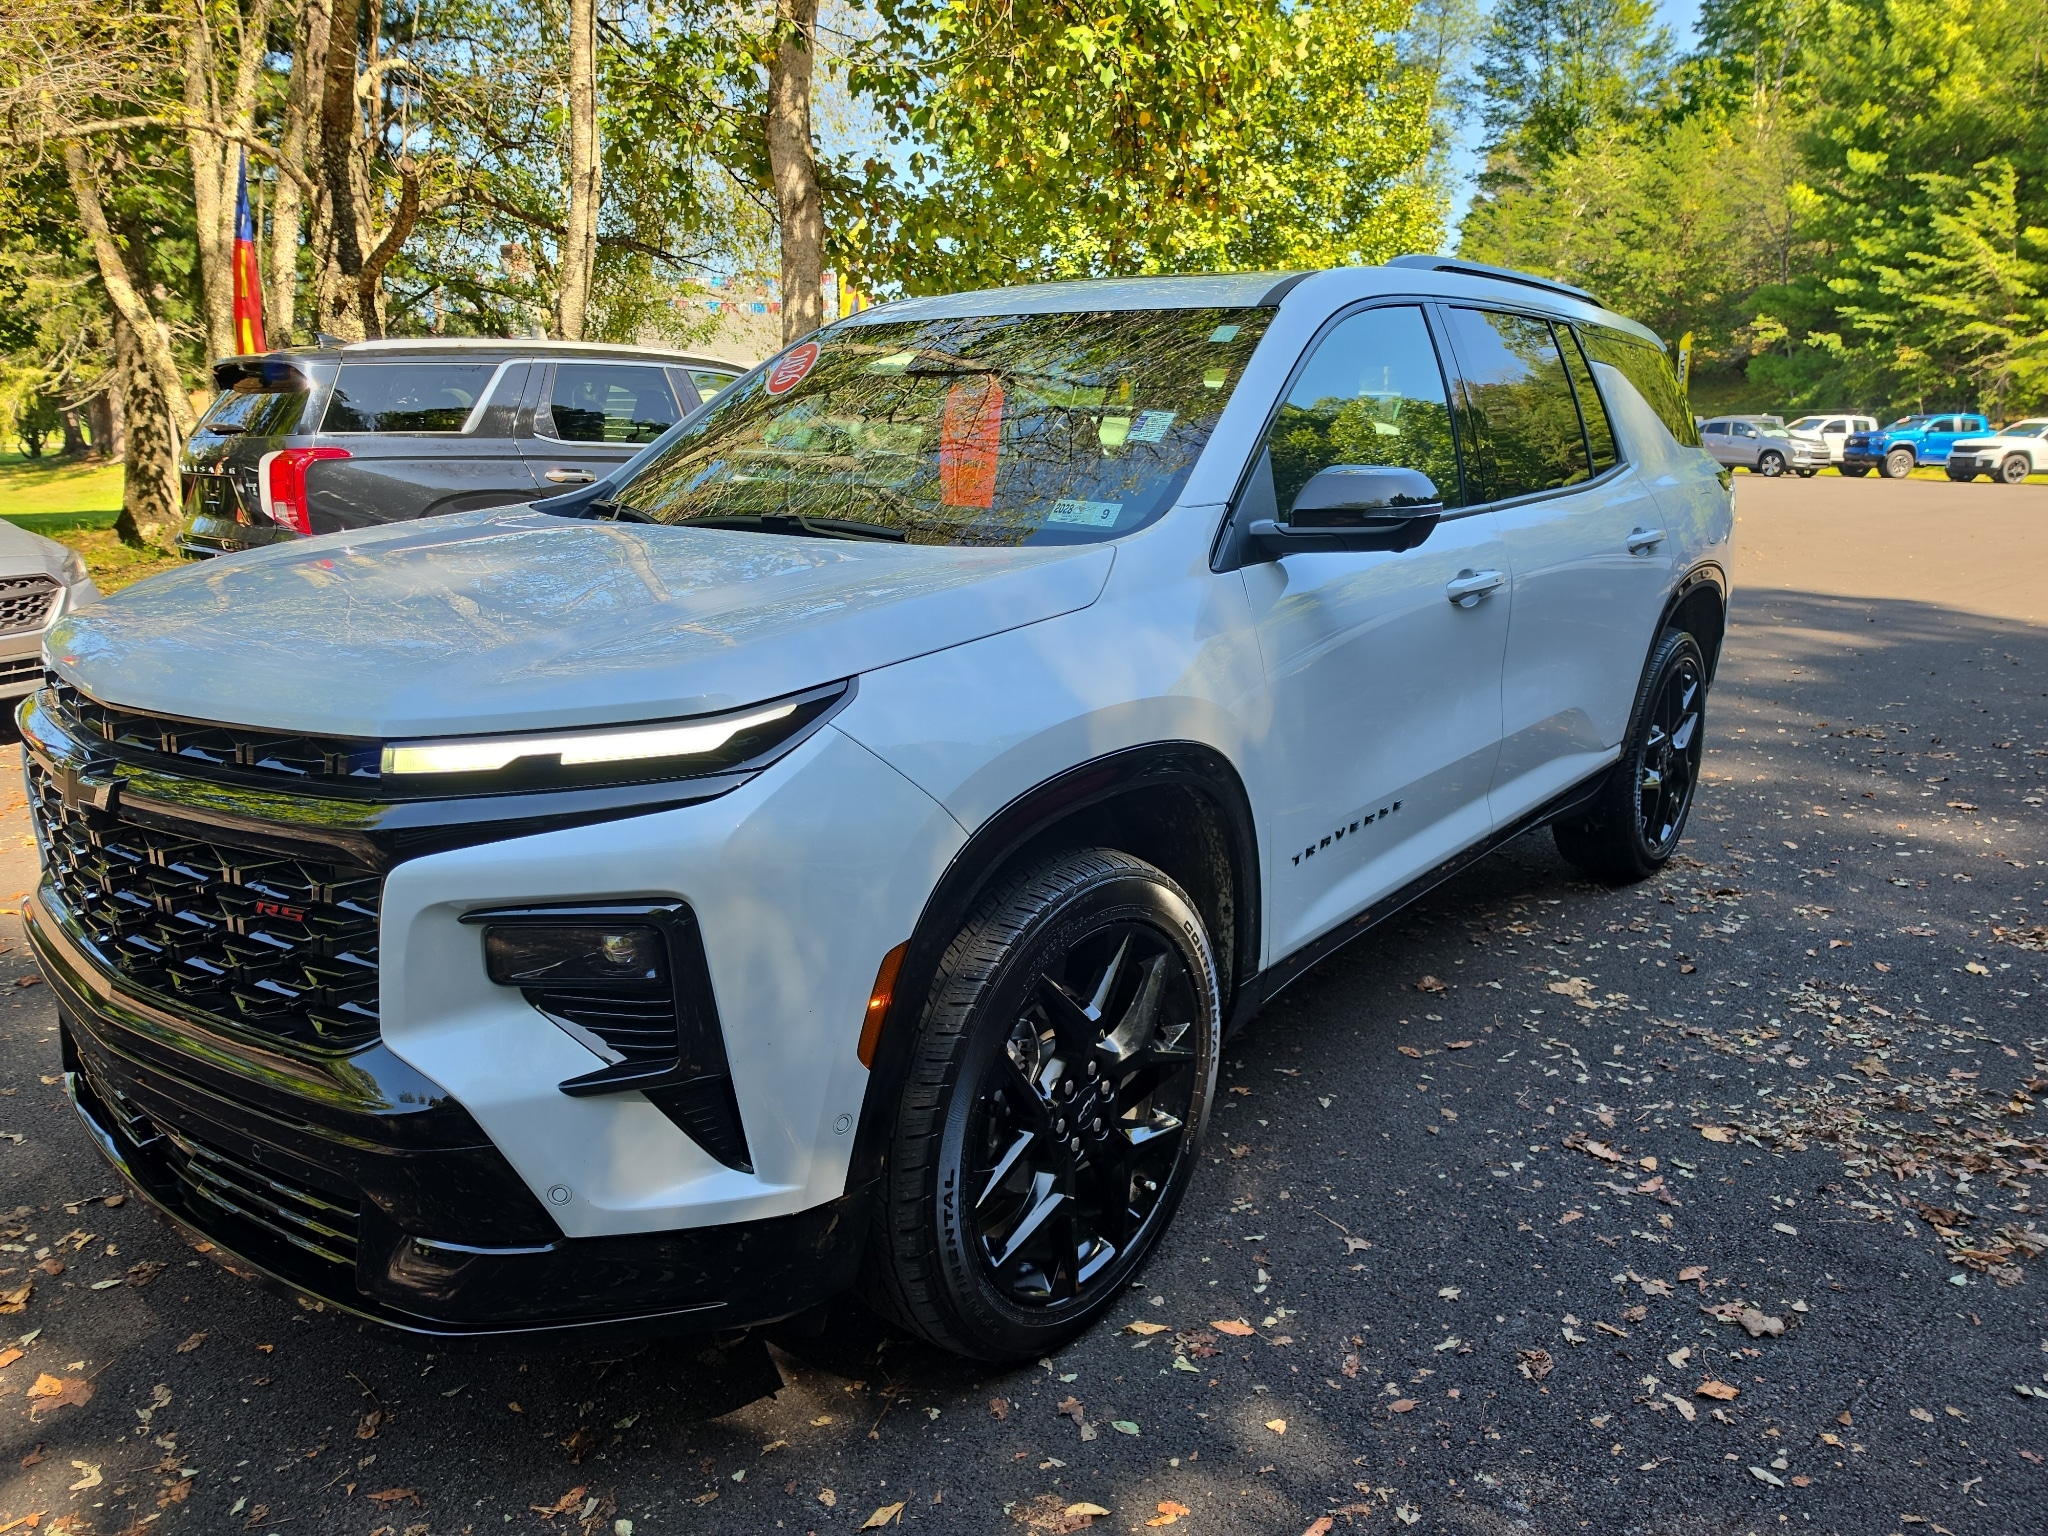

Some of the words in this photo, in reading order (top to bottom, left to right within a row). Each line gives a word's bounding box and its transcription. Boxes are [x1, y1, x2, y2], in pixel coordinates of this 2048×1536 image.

[774, 350, 811, 385] 2026
[1053, 502, 1075, 515] 2028
[1100, 508, 1111, 520] 9
[1291, 798, 1404, 867] TRAVERSE
[256, 900, 304, 922] RS
[1183, 920, 1218, 1072] CONTINENTAL
